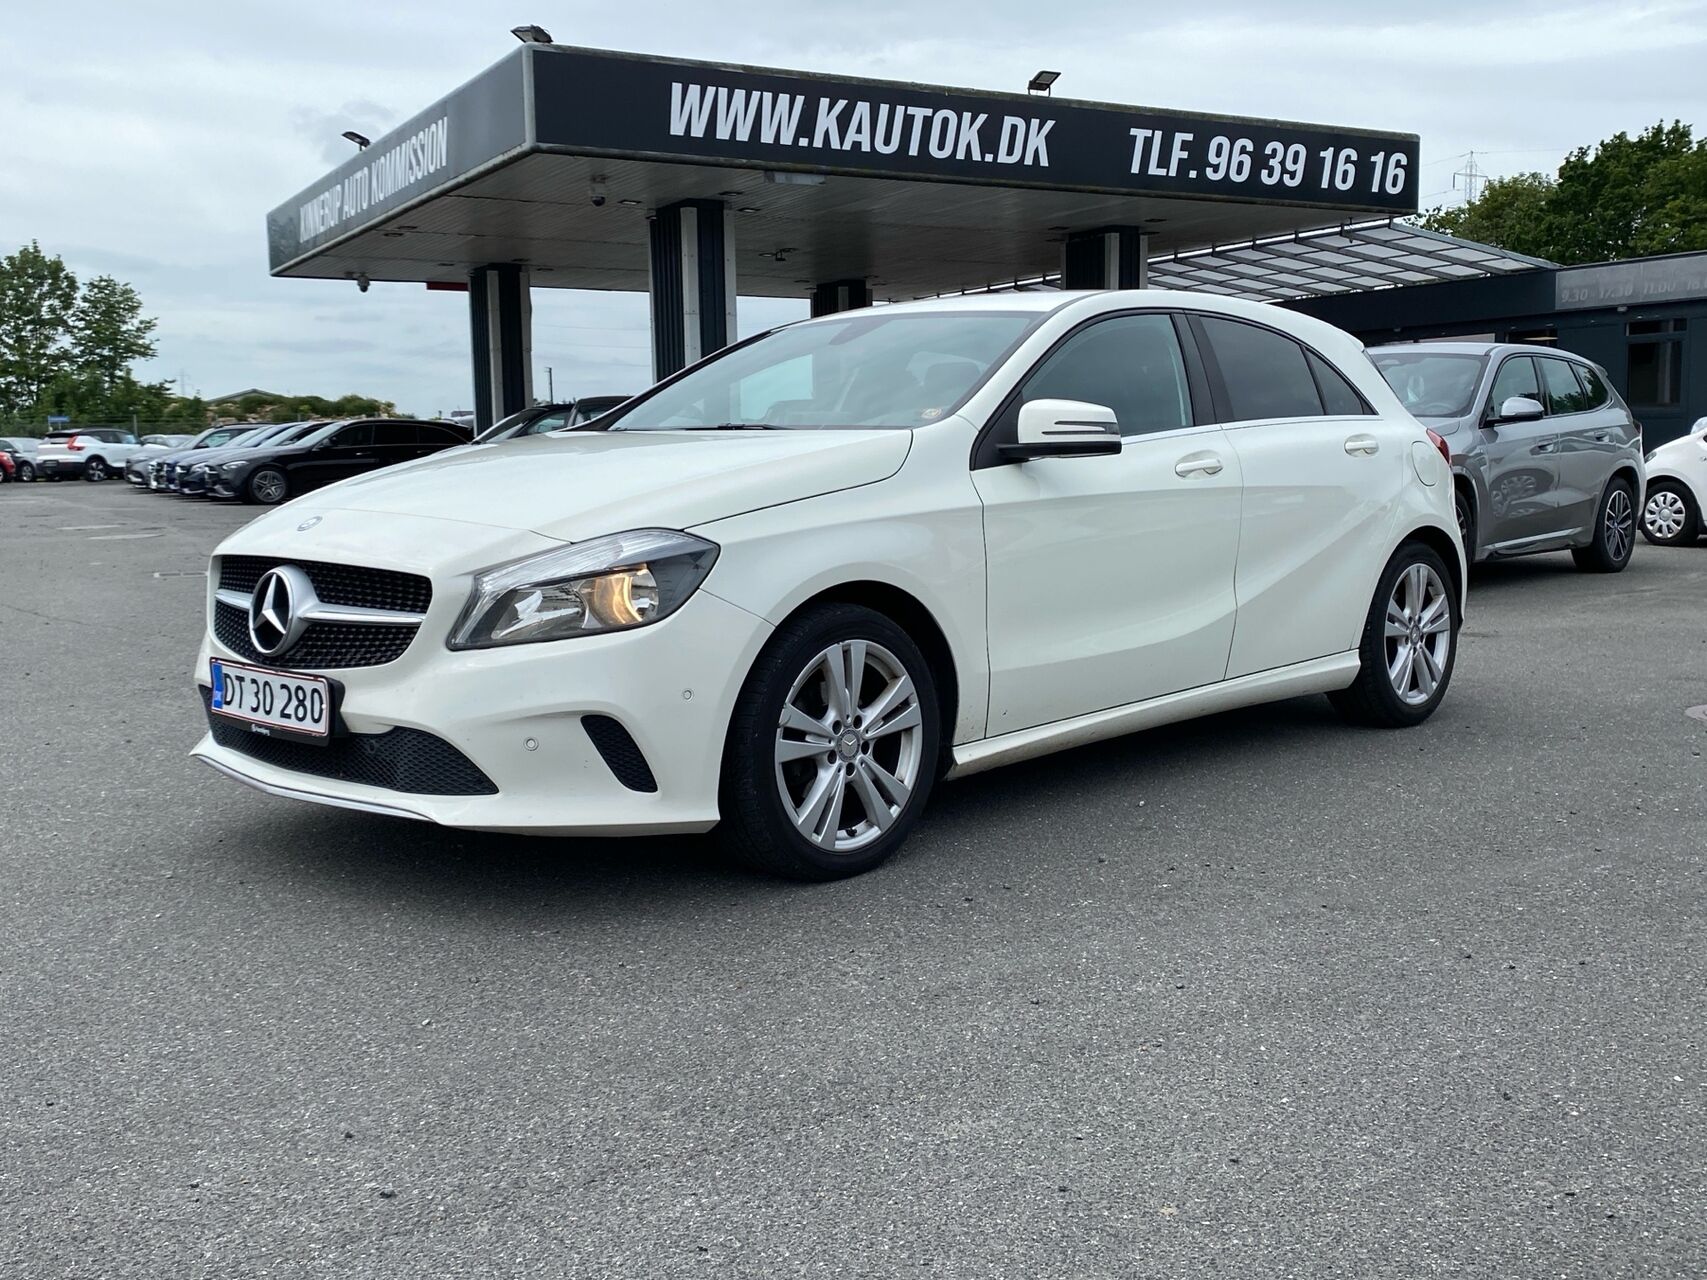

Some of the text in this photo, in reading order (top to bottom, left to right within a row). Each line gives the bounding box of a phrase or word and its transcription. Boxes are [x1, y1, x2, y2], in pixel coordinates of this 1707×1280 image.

[670, 82, 1056, 167] WWW.KAUTOK.DK
[1129, 128, 1408, 195] TLF. 96 39 16 16
[343, 166, 370, 220] AUTO
[371, 117, 448, 205] KOMMISSION
[223, 672, 324, 723] DT 30 280
